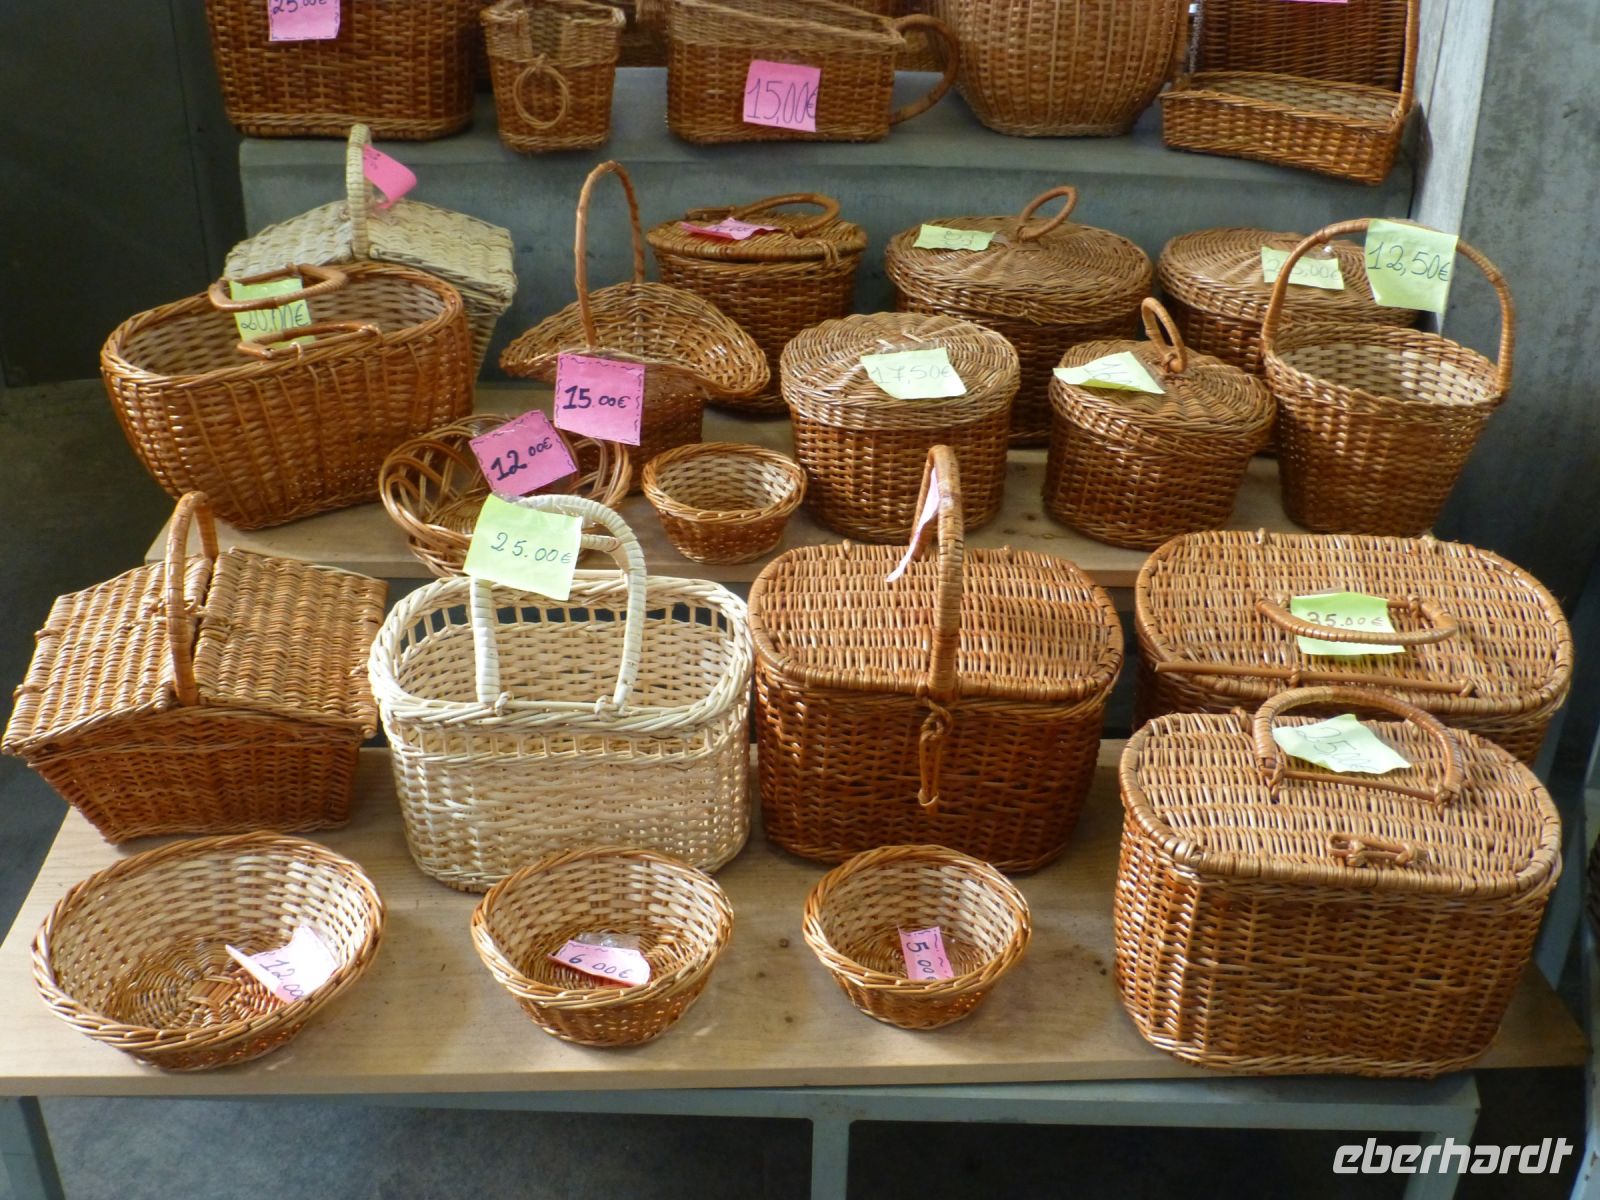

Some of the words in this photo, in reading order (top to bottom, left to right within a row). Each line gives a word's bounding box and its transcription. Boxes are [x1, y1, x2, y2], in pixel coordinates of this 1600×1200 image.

[746, 77, 818, 124] 15,00€
[1367, 241, 1450, 282] 12,50€
[871, 364, 951, 385] 17,50€
[490, 531, 572, 564] 25.00€
